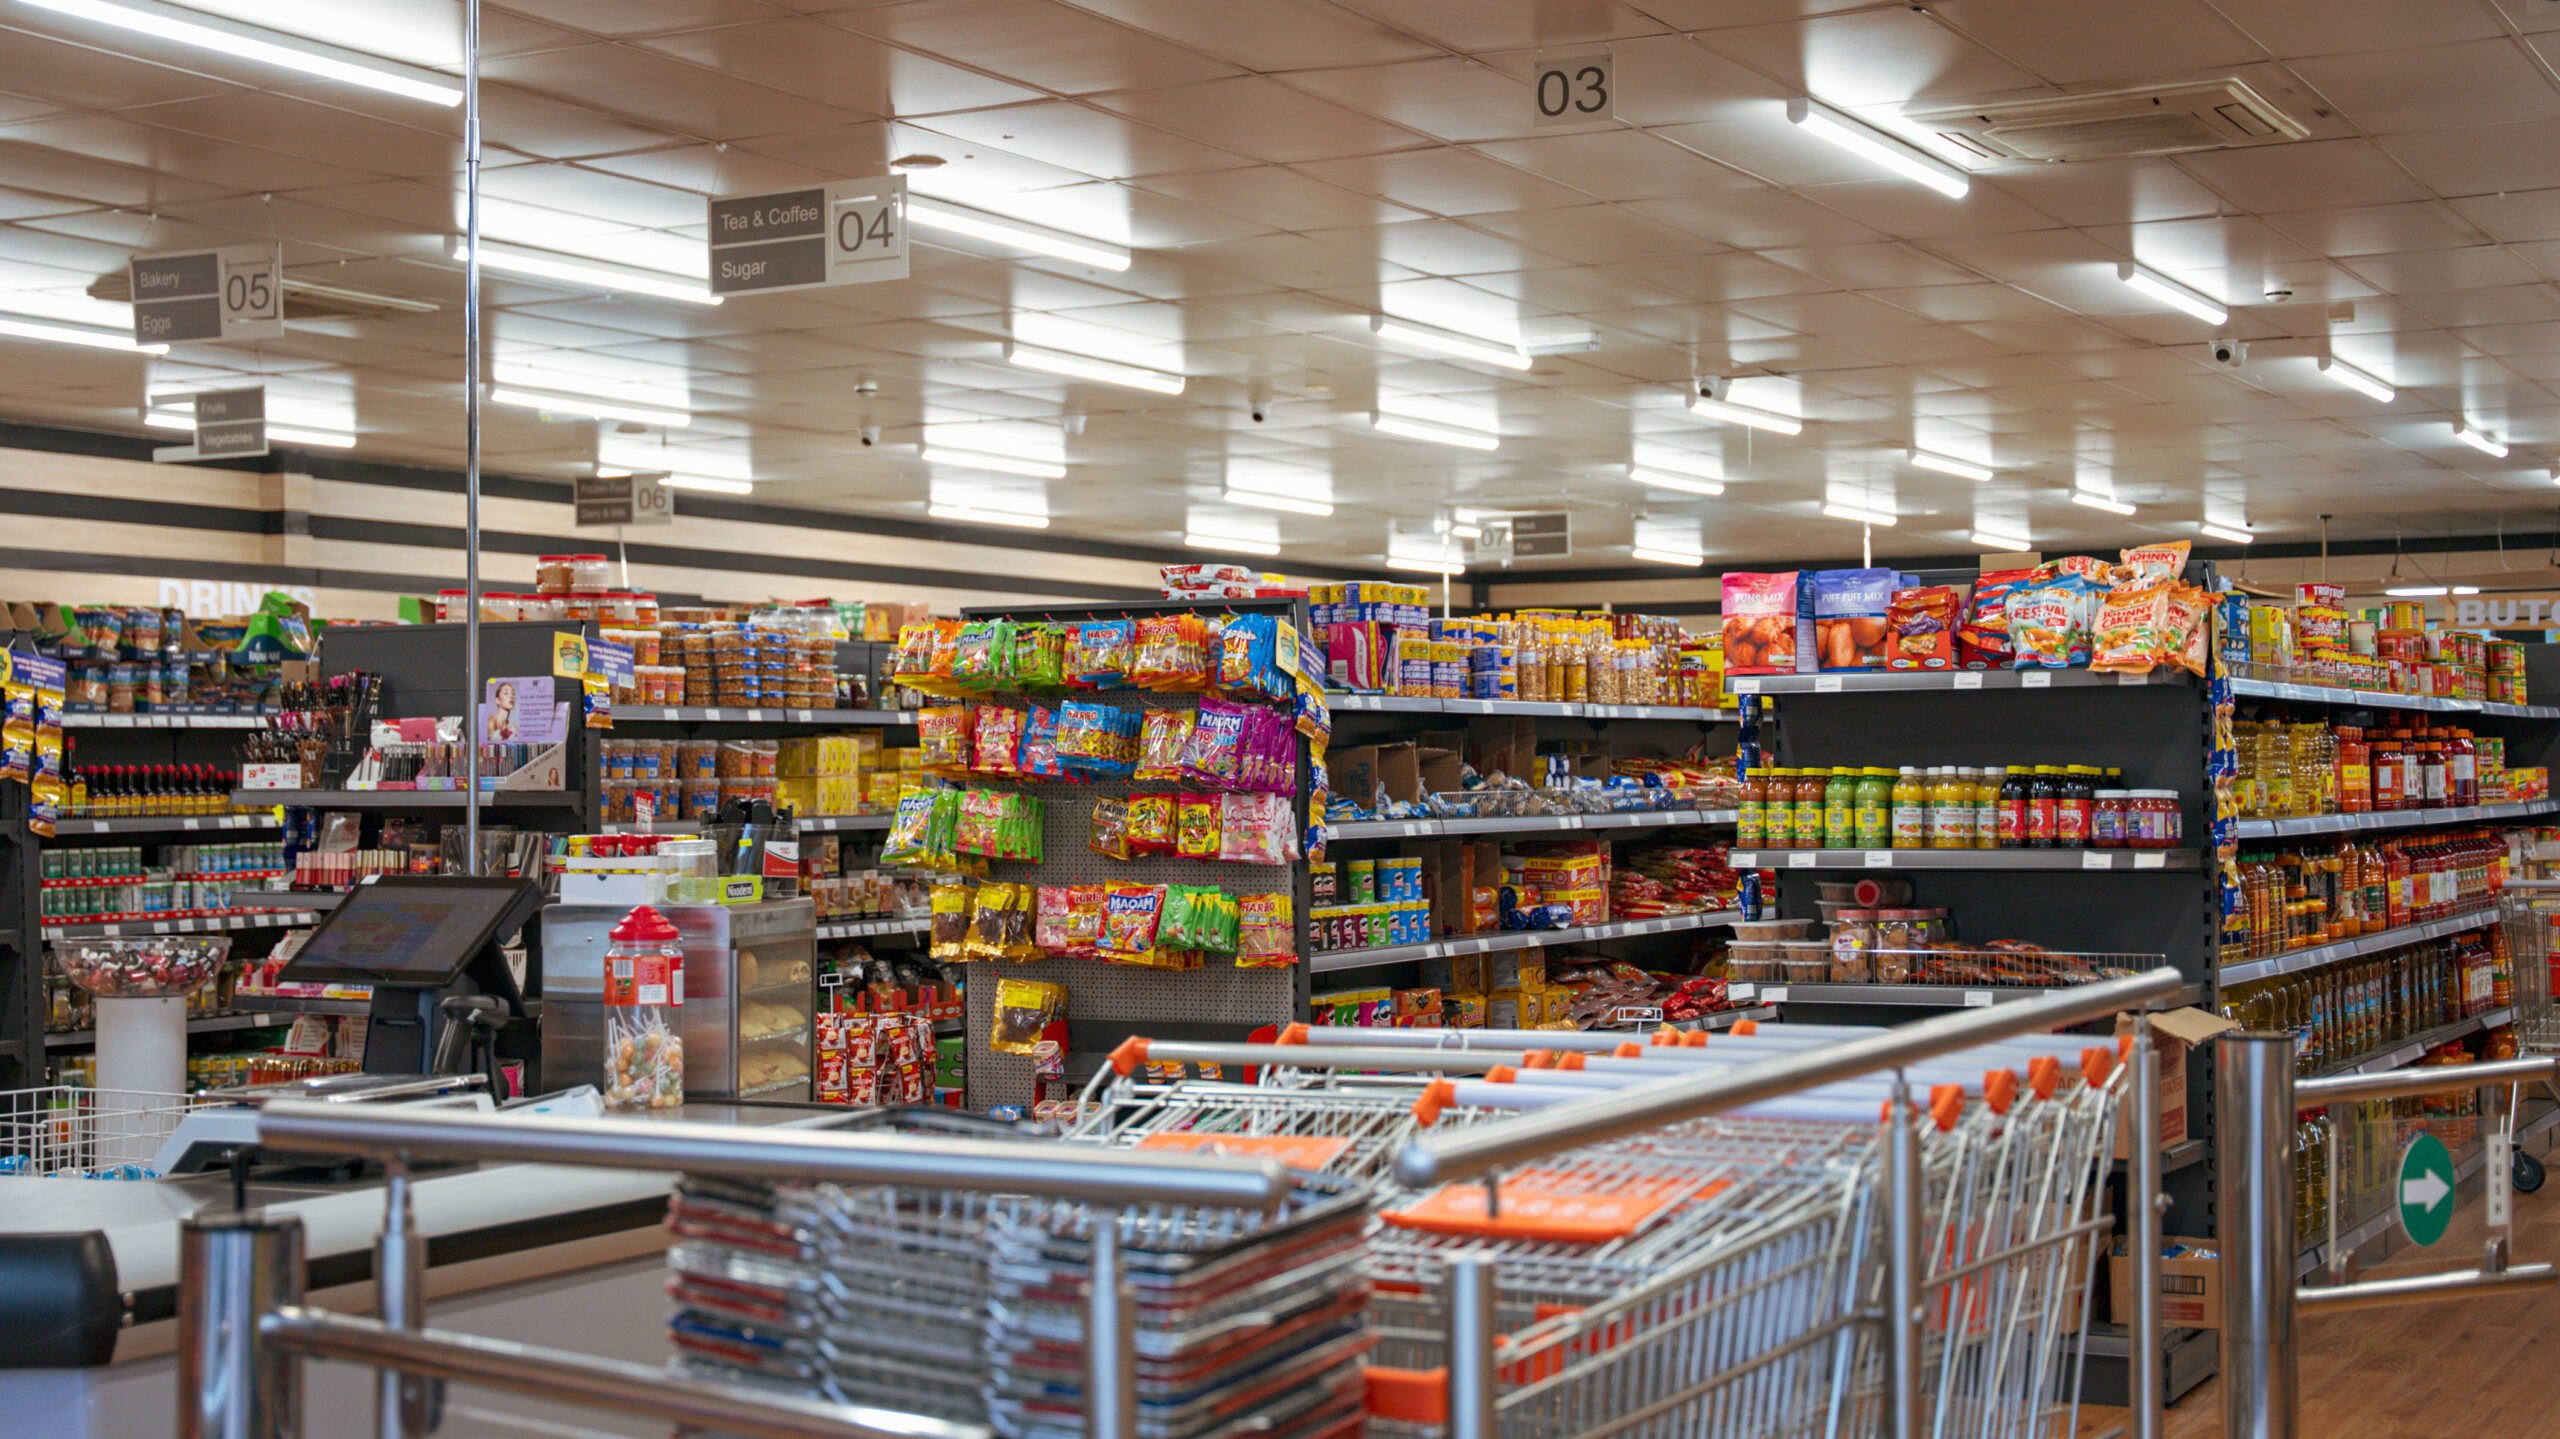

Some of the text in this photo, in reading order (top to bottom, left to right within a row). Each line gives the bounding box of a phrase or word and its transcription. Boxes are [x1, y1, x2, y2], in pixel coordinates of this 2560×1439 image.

[1538, 66, 1607, 116] 03
[721, 206, 818, 231] Tea & Coffee
[838, 207, 894, 252] 04
[721, 261, 767, 280] Sugar
[140, 272, 180, 288] Bakery
[227, 273, 270, 311] 05
[142, 315, 172, 334] Eggs
[203, 432, 255, 448] Vegetables
[638, 487, 667, 511] 06
[1482, 528, 1507, 547] 07
[158, 578, 317, 620] DRINS
[1764, 591, 1784, 603] MIX
[1864, 591, 1884, 602] MIX
[2104, 604, 2154, 620] JOHNNY
[2102, 616, 2131, 629] CAKE
[1086, 628, 1119, 639] HARIBO
[923, 715, 958, 728] HARIBO
[1066, 710, 1098, 721] HARIBO
[1200, 711, 1242, 731] MAOAM
[1111, 897, 1154, 911] MAOAM
[1242, 901, 1275, 913] HARIBO
